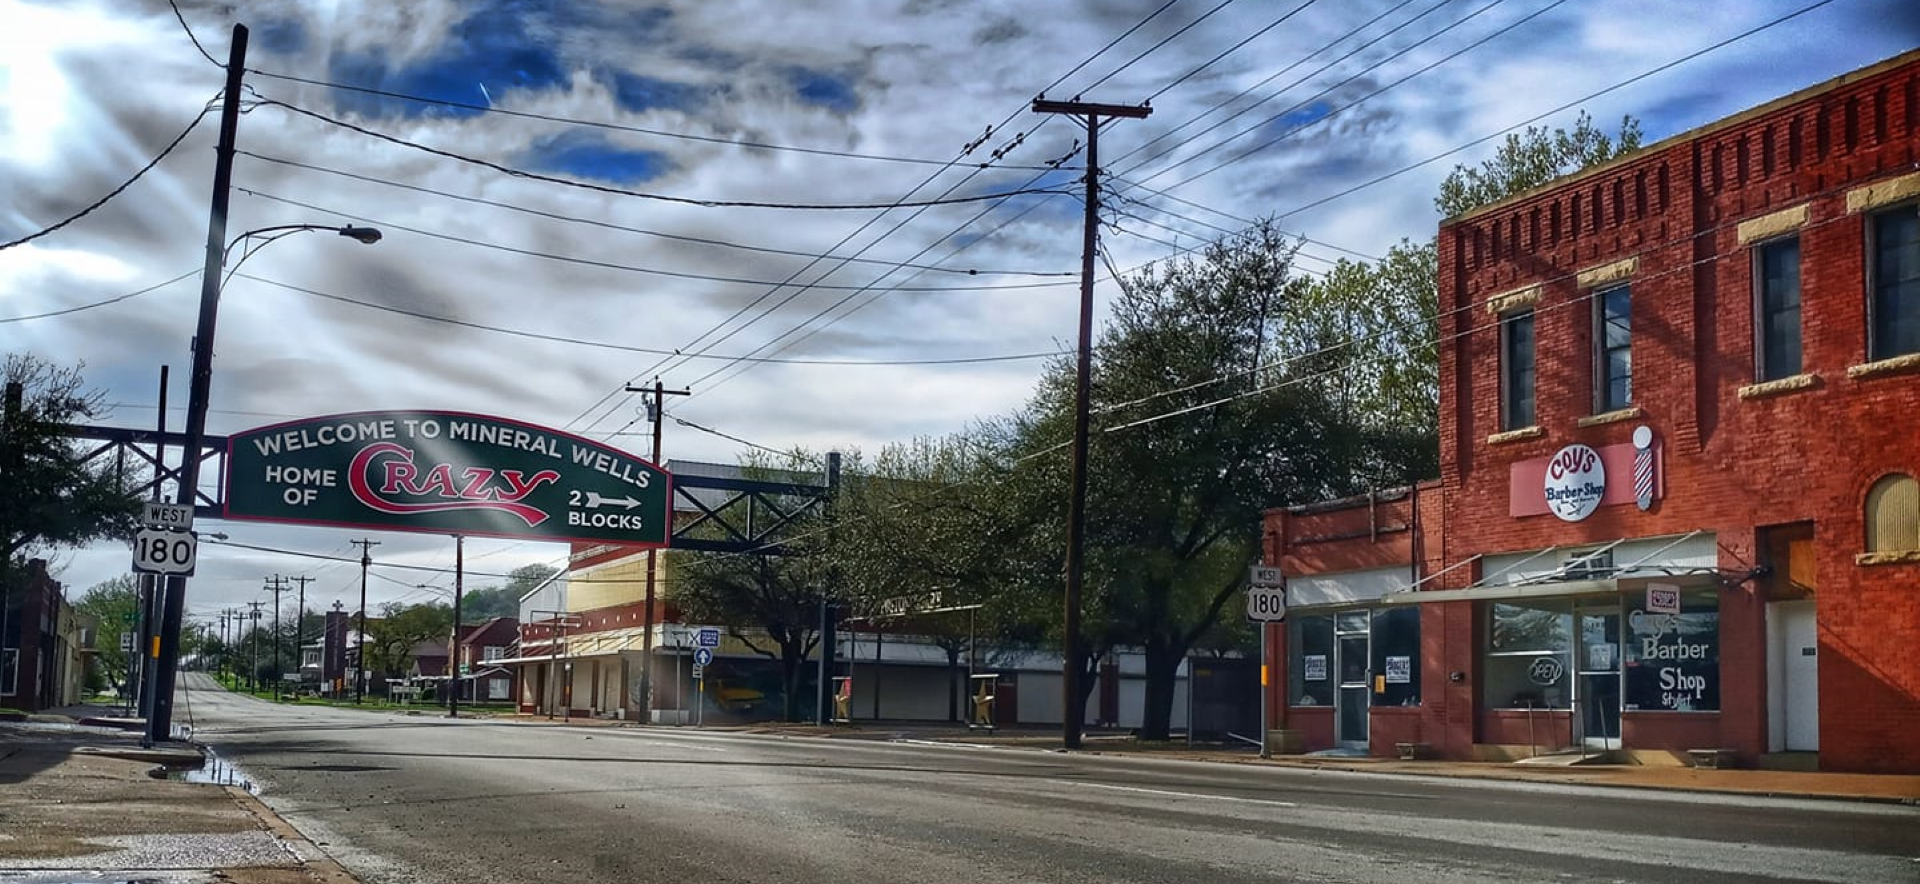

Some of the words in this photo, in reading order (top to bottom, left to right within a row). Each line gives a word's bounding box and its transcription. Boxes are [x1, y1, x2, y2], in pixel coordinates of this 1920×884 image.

[254, 420, 396, 457] WELCOME
[404, 419, 441, 439] TO
[449, 421, 562, 459] MINERAL
[572, 444, 651, 488] WELLS
[265, 465, 337, 487] HOME
[348, 441, 561, 527] CRAZY
[283, 487, 318, 506] OF
[568, 490, 582, 507] 2
[1546, 485, 1583, 500] Barber
[151, 506, 187, 523] WEST
[568, 511, 642, 530] BLOCKS
[140, 537, 190, 565] 180
[1257, 570, 1276, 581] WEST
[1253, 594, 1279, 615] 180
[1642, 637, 1709, 660] Barber
[1659, 667, 1706, 699] Shop
